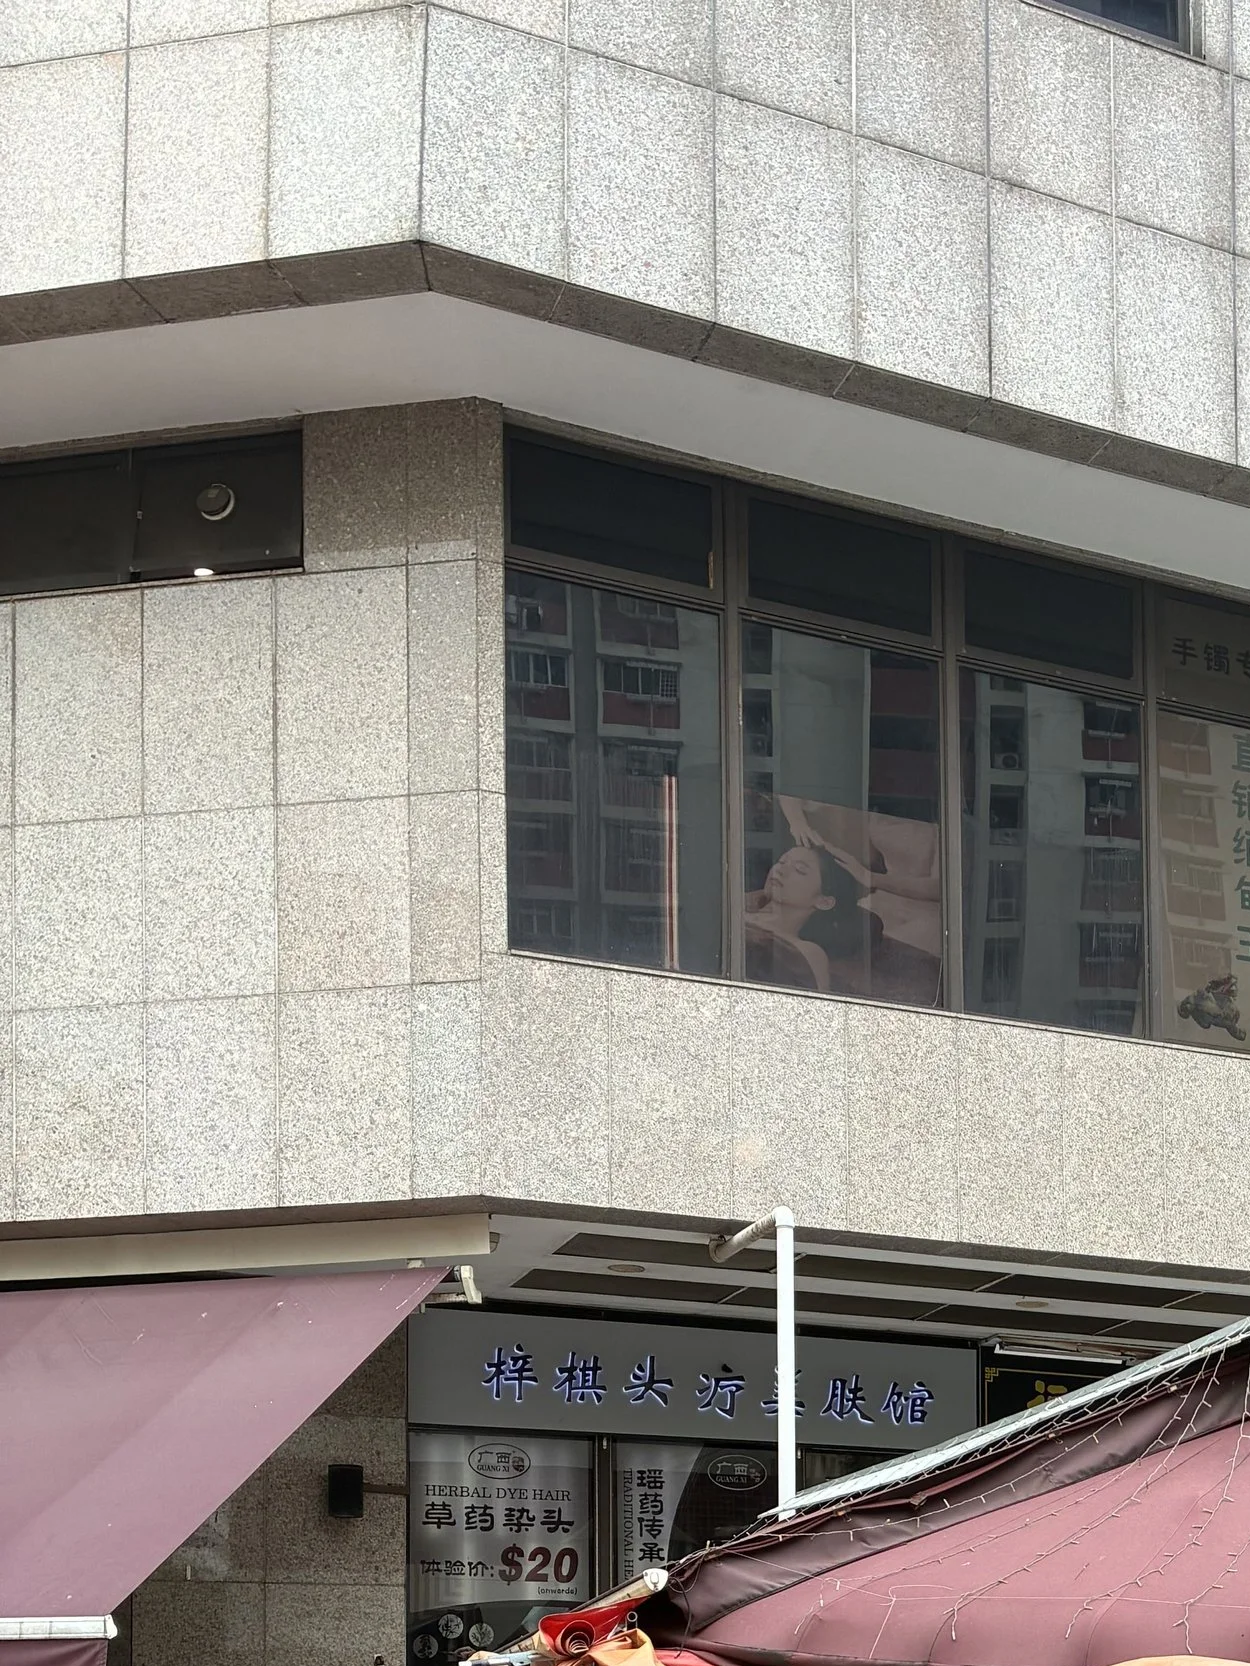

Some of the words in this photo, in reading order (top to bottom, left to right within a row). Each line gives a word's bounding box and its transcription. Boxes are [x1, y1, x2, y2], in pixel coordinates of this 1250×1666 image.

[477, 1450, 512, 1464] 广西
[502, 1465, 510, 1473] XI
[716, 1462, 749, 1476] 广西
[715, 1475, 739, 1483] GUANG
[424, 1484, 492, 1499] HERBAL
[495, 1487, 528, 1500] DYE
[532, 1489, 572, 1501] HAIR
[421, 1501, 575, 1533] 草药染头
[623, 1468, 634, 1557] TRADITIONAL
[636, 1469, 665, 1563] 瑶药传承
[420, 1559, 495, 1577] 体验价:
[498, 1543, 579, 1585] $20
